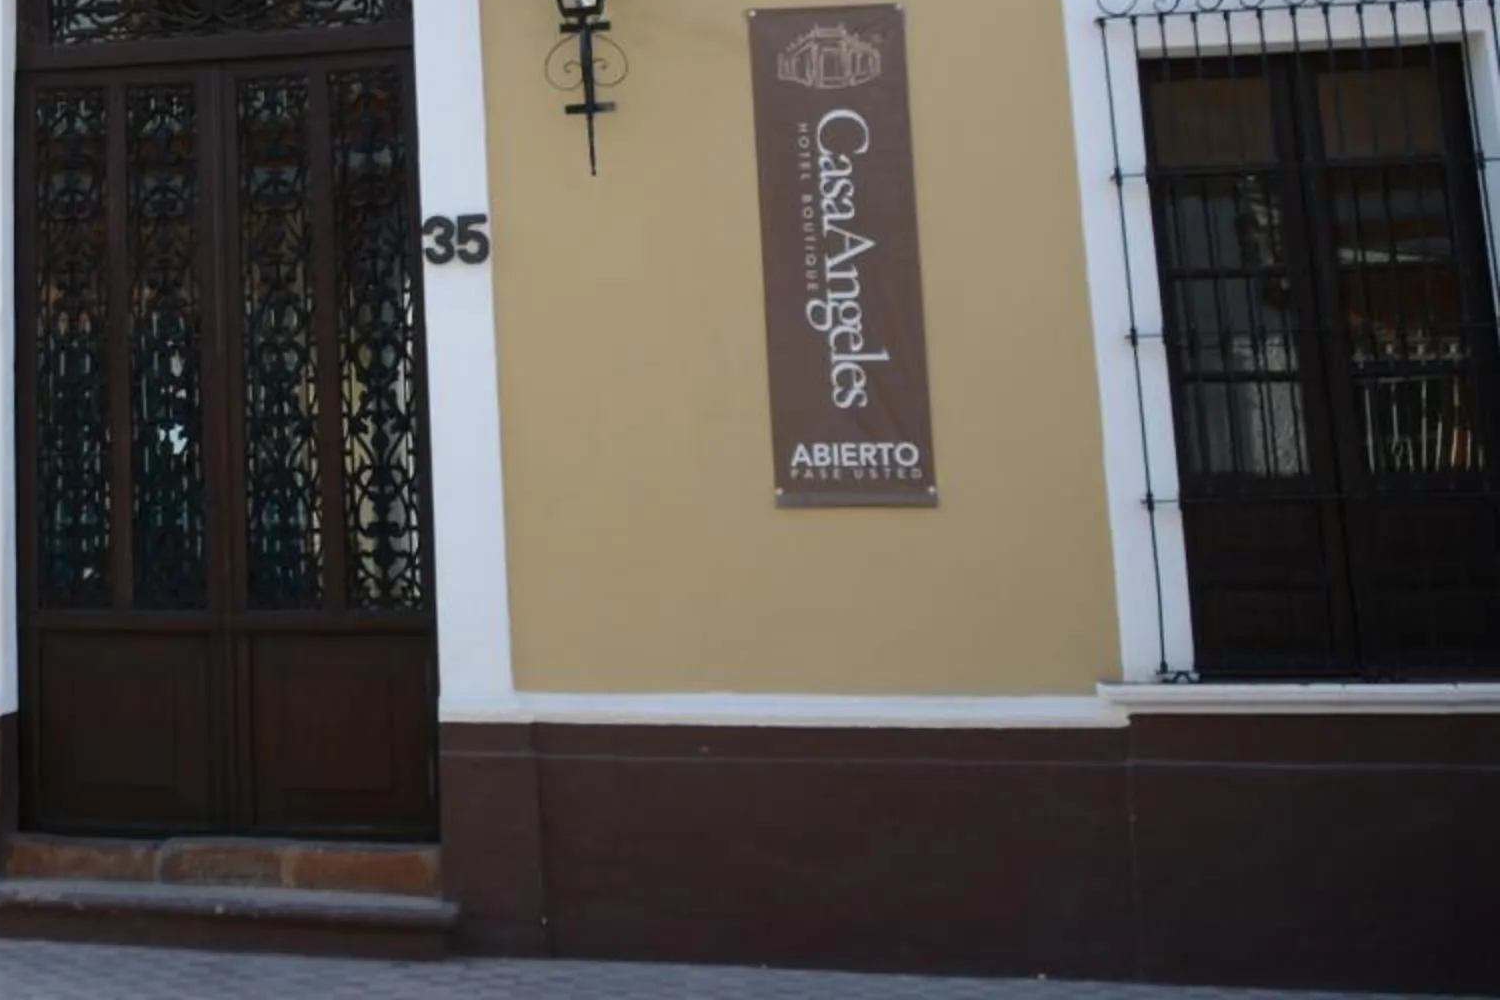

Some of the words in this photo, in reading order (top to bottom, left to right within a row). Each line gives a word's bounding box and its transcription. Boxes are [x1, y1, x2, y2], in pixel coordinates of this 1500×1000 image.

[797, 122, 812, 180] HOTEL
[422, 213, 490, 265] 35
[801, 193, 819, 291] BOUTIQUE
[790, 442, 920, 467] ABIERTO
